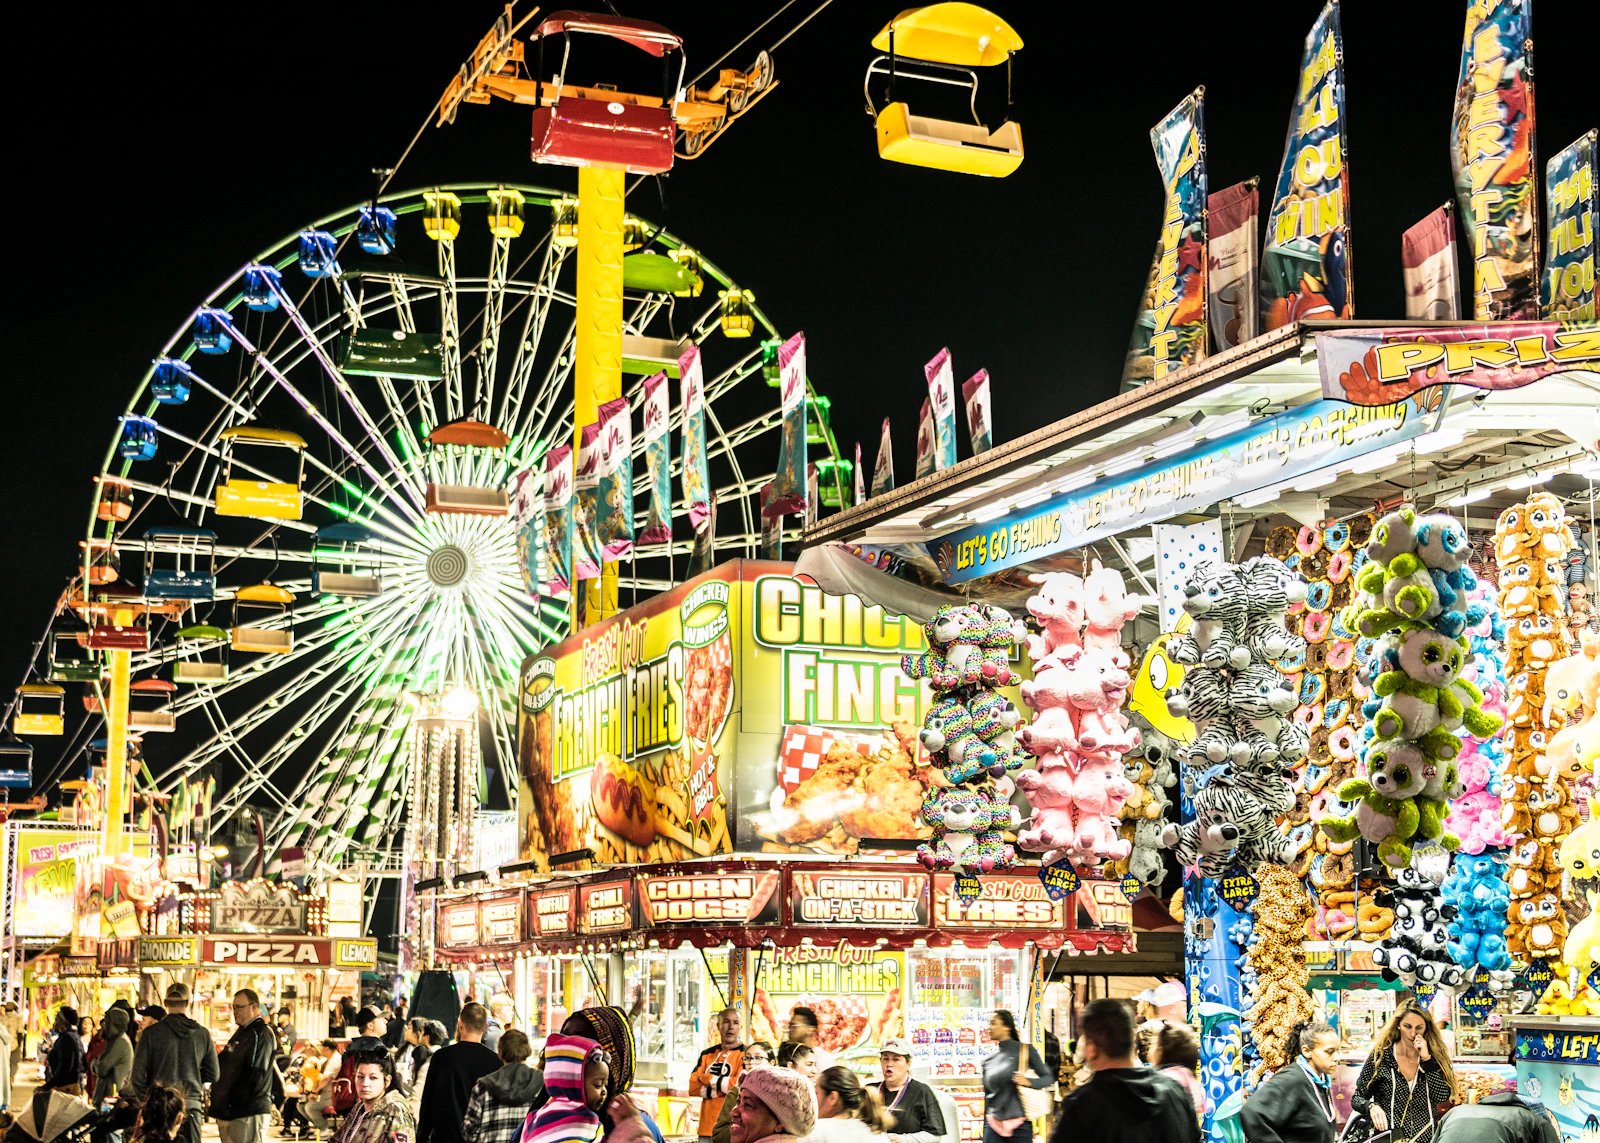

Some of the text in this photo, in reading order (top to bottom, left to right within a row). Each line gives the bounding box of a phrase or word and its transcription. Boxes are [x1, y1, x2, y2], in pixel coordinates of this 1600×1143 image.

[1298, 29, 1336, 104] SH
[1296, 134, 1342, 187] OU
[1552, 165, 1592, 218] FISH
[1549, 211, 1594, 261] TILL
[1549, 255, 1595, 304] YOU
[956, 510, 1062, 572] LET'S GO FISHING
[682, 582, 729, 619] CHICKEN
[684, 608, 728, 647] WINGS
[583, 618, 648, 690] FRESH CUT
[523, 658, 556, 685] CHICKEN
[552, 641, 685, 782] FRENCH FRIES
[690, 753, 716, 791] HOT &
[694, 780, 715, 816] BBQ
[30, 846, 55, 863] FRESH
[959, 878, 979, 888] EXTRA
[1045, 877, 1076, 891] LARGE
[1048, 866, 1077, 882] EXTRA
[1124, 879, 1140, 888] EXTRA
[1223, 876, 1253, 889] EXTRA
[590, 887, 623, 908] CHILI
[648, 878, 752, 899] CORN
[819, 878, 902, 899] CHICKEN
[958, 886, 980, 897] LARGE
[1011, 880, 1046, 902] CUT
[1123, 885, 1141, 894] LARGE
[1223, 886, 1255, 899] LARGE
[537, 893, 570, 915] BUFFALO
[651, 898, 749, 921] DOGS
[804, 898, 917, 922] ON-A-STICK
[947, 899, 1053, 923] FRIES
[219, 908, 298, 928] PIZZA
[539, 913, 568, 932] WINGS
[590, 906, 625, 928] FRIES
[213, 942, 319, 963] PIZZA
[838, 938, 876, 966] CUT
[754, 958, 900, 995] FRENCH FRIES
[1475, 973, 1489, 984] LARGE
[1529, 970, 1551, 982] LARGE
[1416, 984, 1435, 995] LARGE
[1464, 996, 1493, 1007] LARGE
